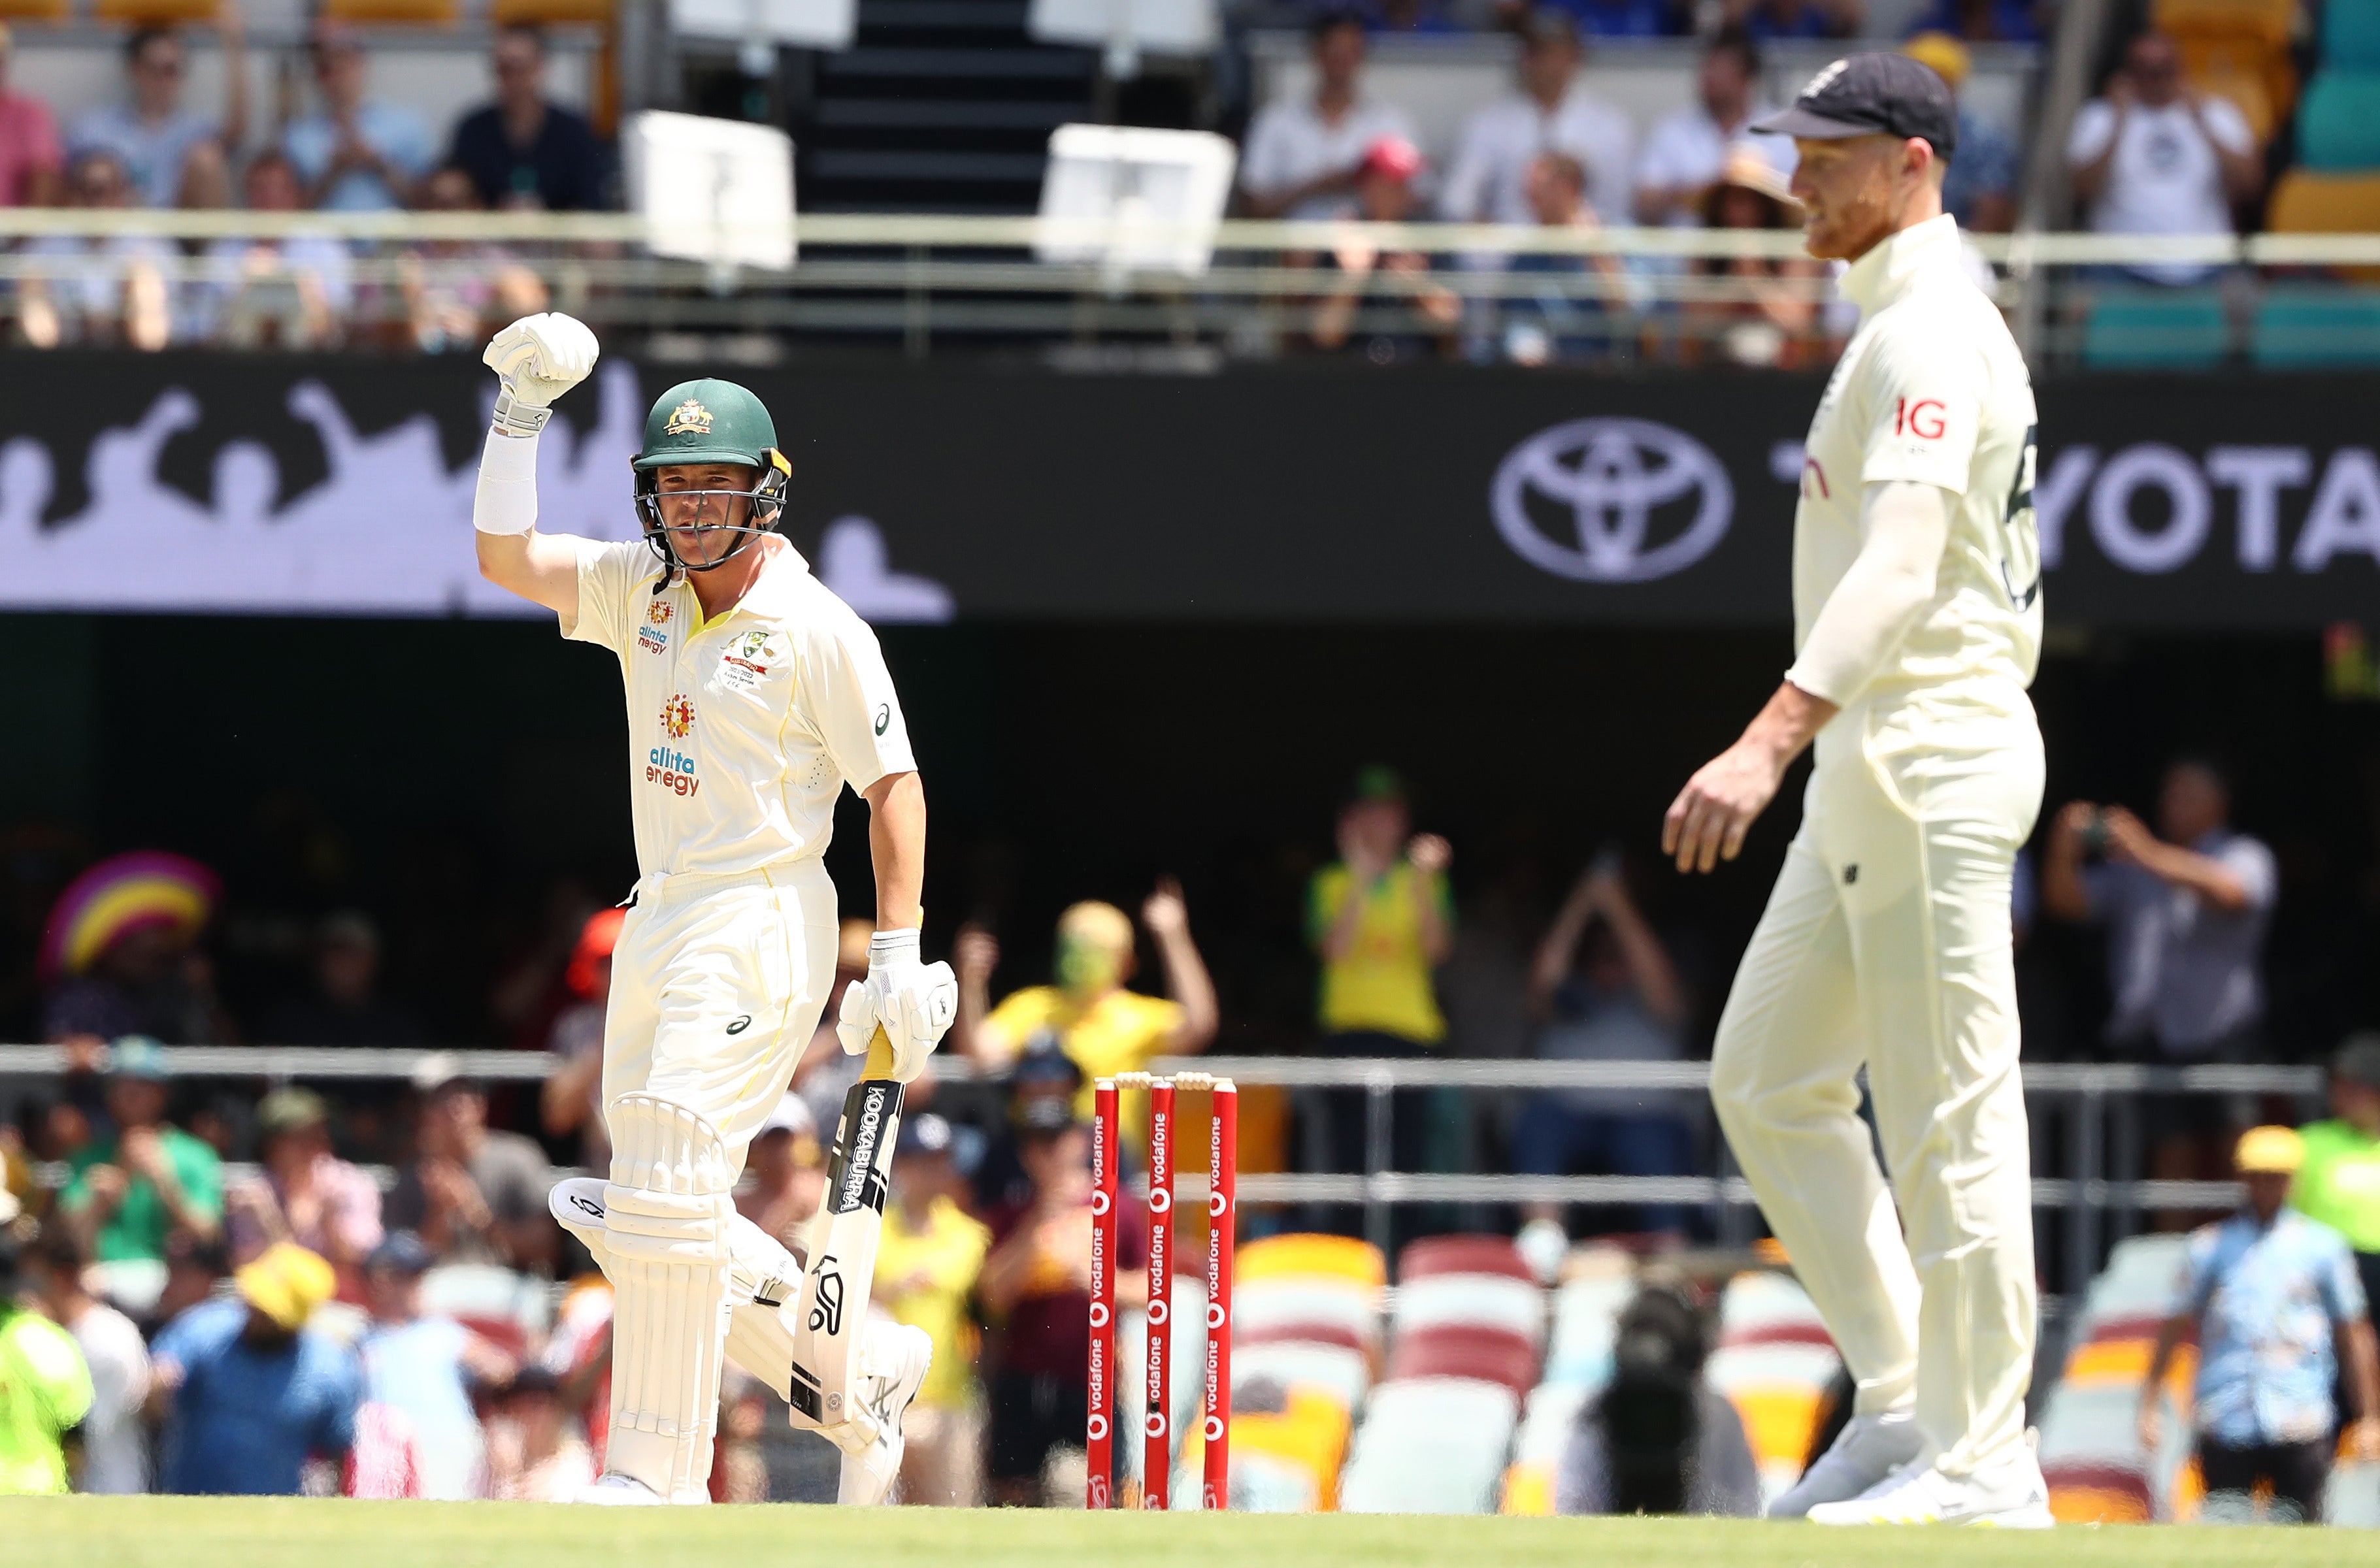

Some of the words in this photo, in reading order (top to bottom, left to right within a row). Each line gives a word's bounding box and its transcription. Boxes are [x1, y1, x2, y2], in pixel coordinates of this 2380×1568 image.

[1894, 397, 1947, 440] IG
[1768, 442, 2380, 574] YOTA
[638, 637, 667, 655] nergy
[646, 766, 700, 797] enegy
[838, 1086, 887, 1211] KOOKABURRA
[1092, 1115, 1104, 1187] vodafone
[1151, 1111, 1166, 1185] vodafone
[1210, 1115, 1221, 1188] vodafone
[1091, 1227, 1104, 1299] vodafone
[1149, 1224, 1165, 1296] vodafone
[1208, 1228, 1219, 1300] vodafone
[1089, 1338, 1102, 1411] vodafone
[1148, 1335, 1161, 1403] odafone
[1207, 1339, 1219, 1413] vodafone
